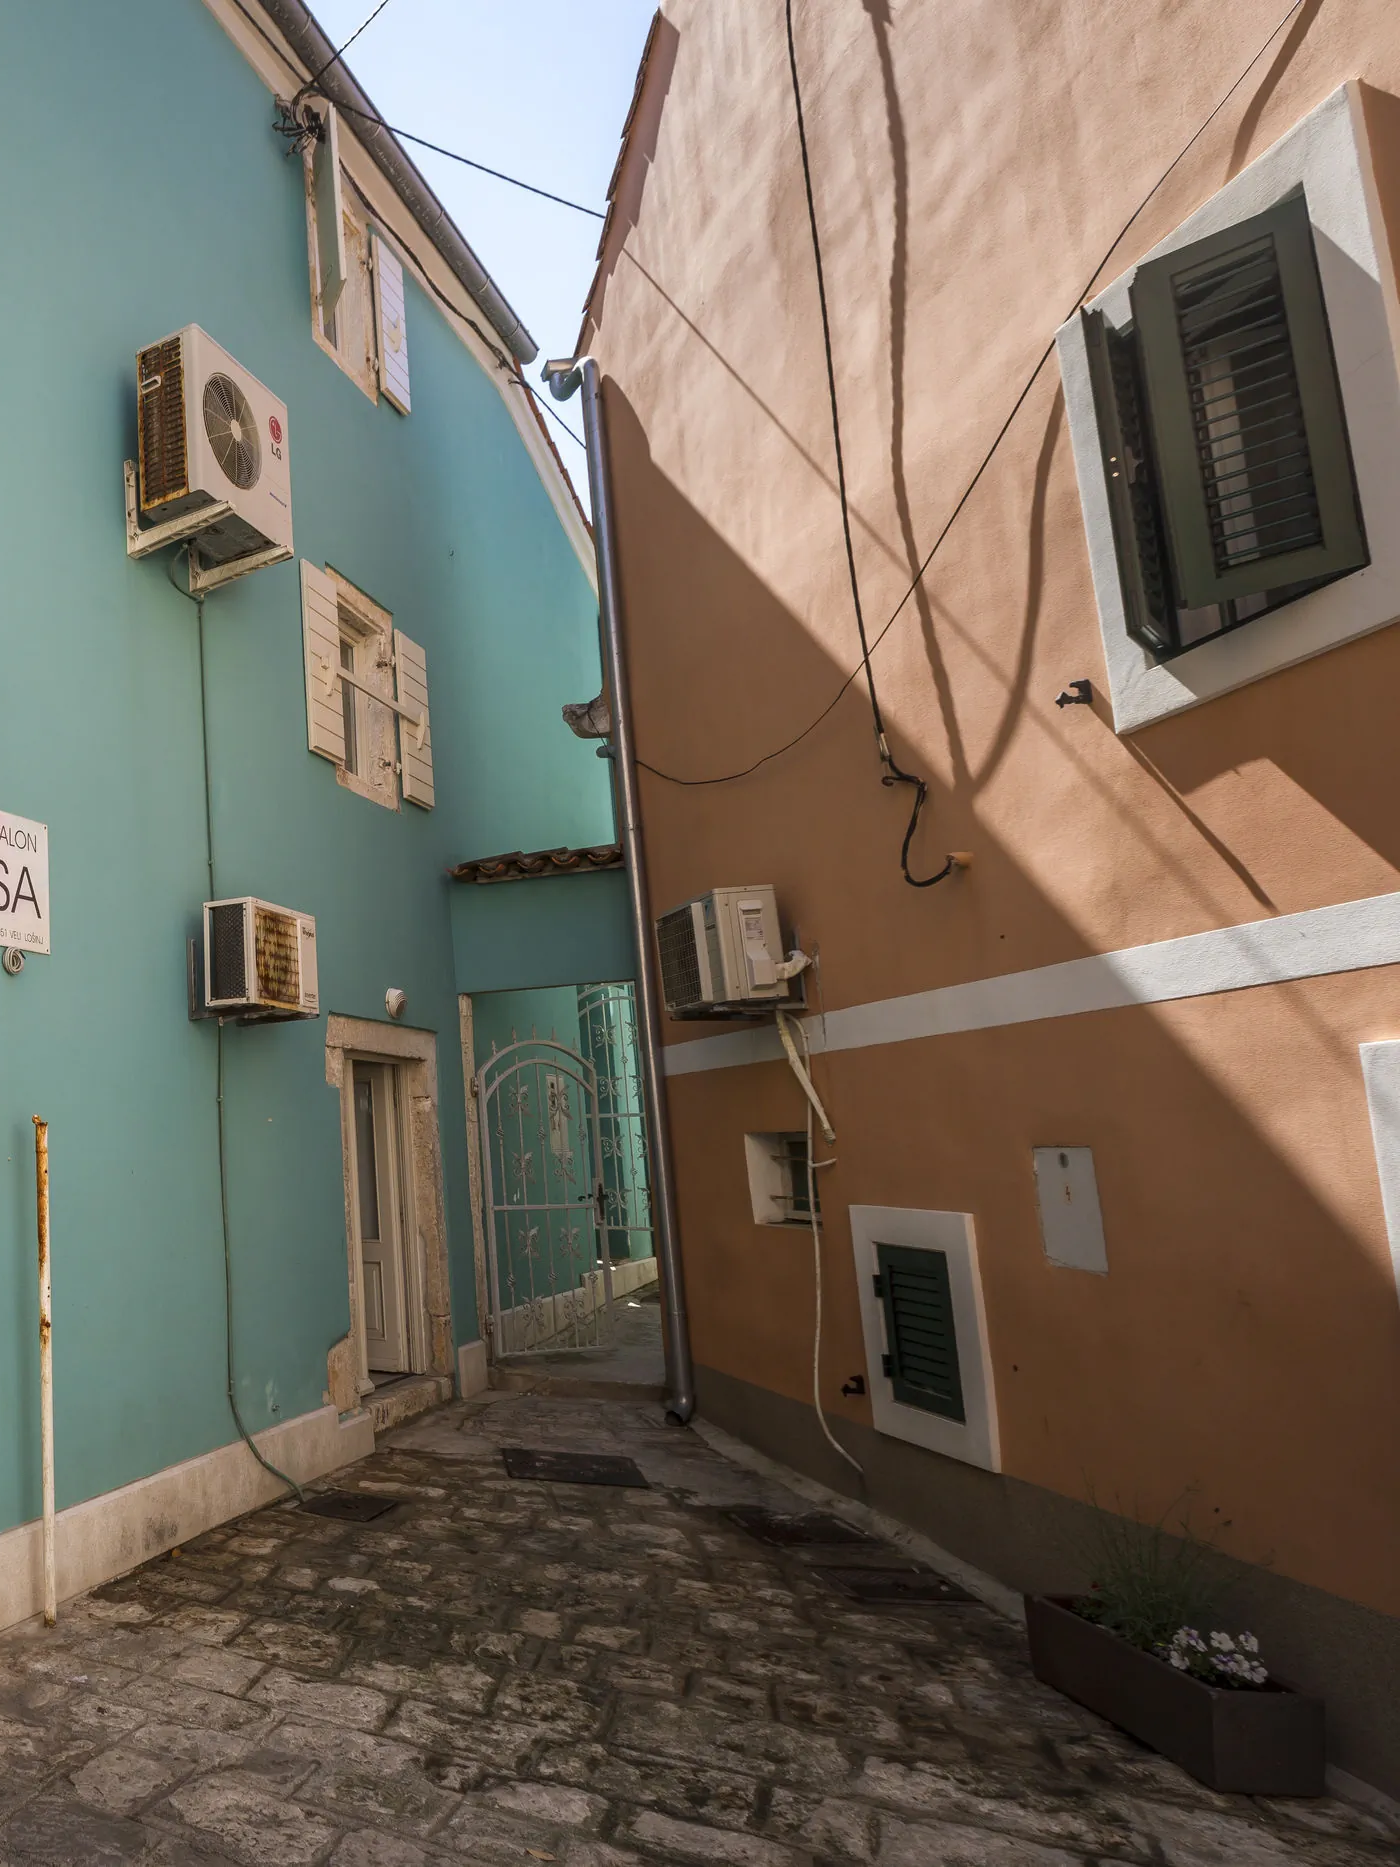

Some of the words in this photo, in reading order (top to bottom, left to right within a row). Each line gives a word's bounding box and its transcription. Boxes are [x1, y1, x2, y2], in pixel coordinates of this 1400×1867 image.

[271, 443, 282, 461] LG
[9, 930, 22, 941] VELI
[24, 932, 44, 945] LOŠINJ
